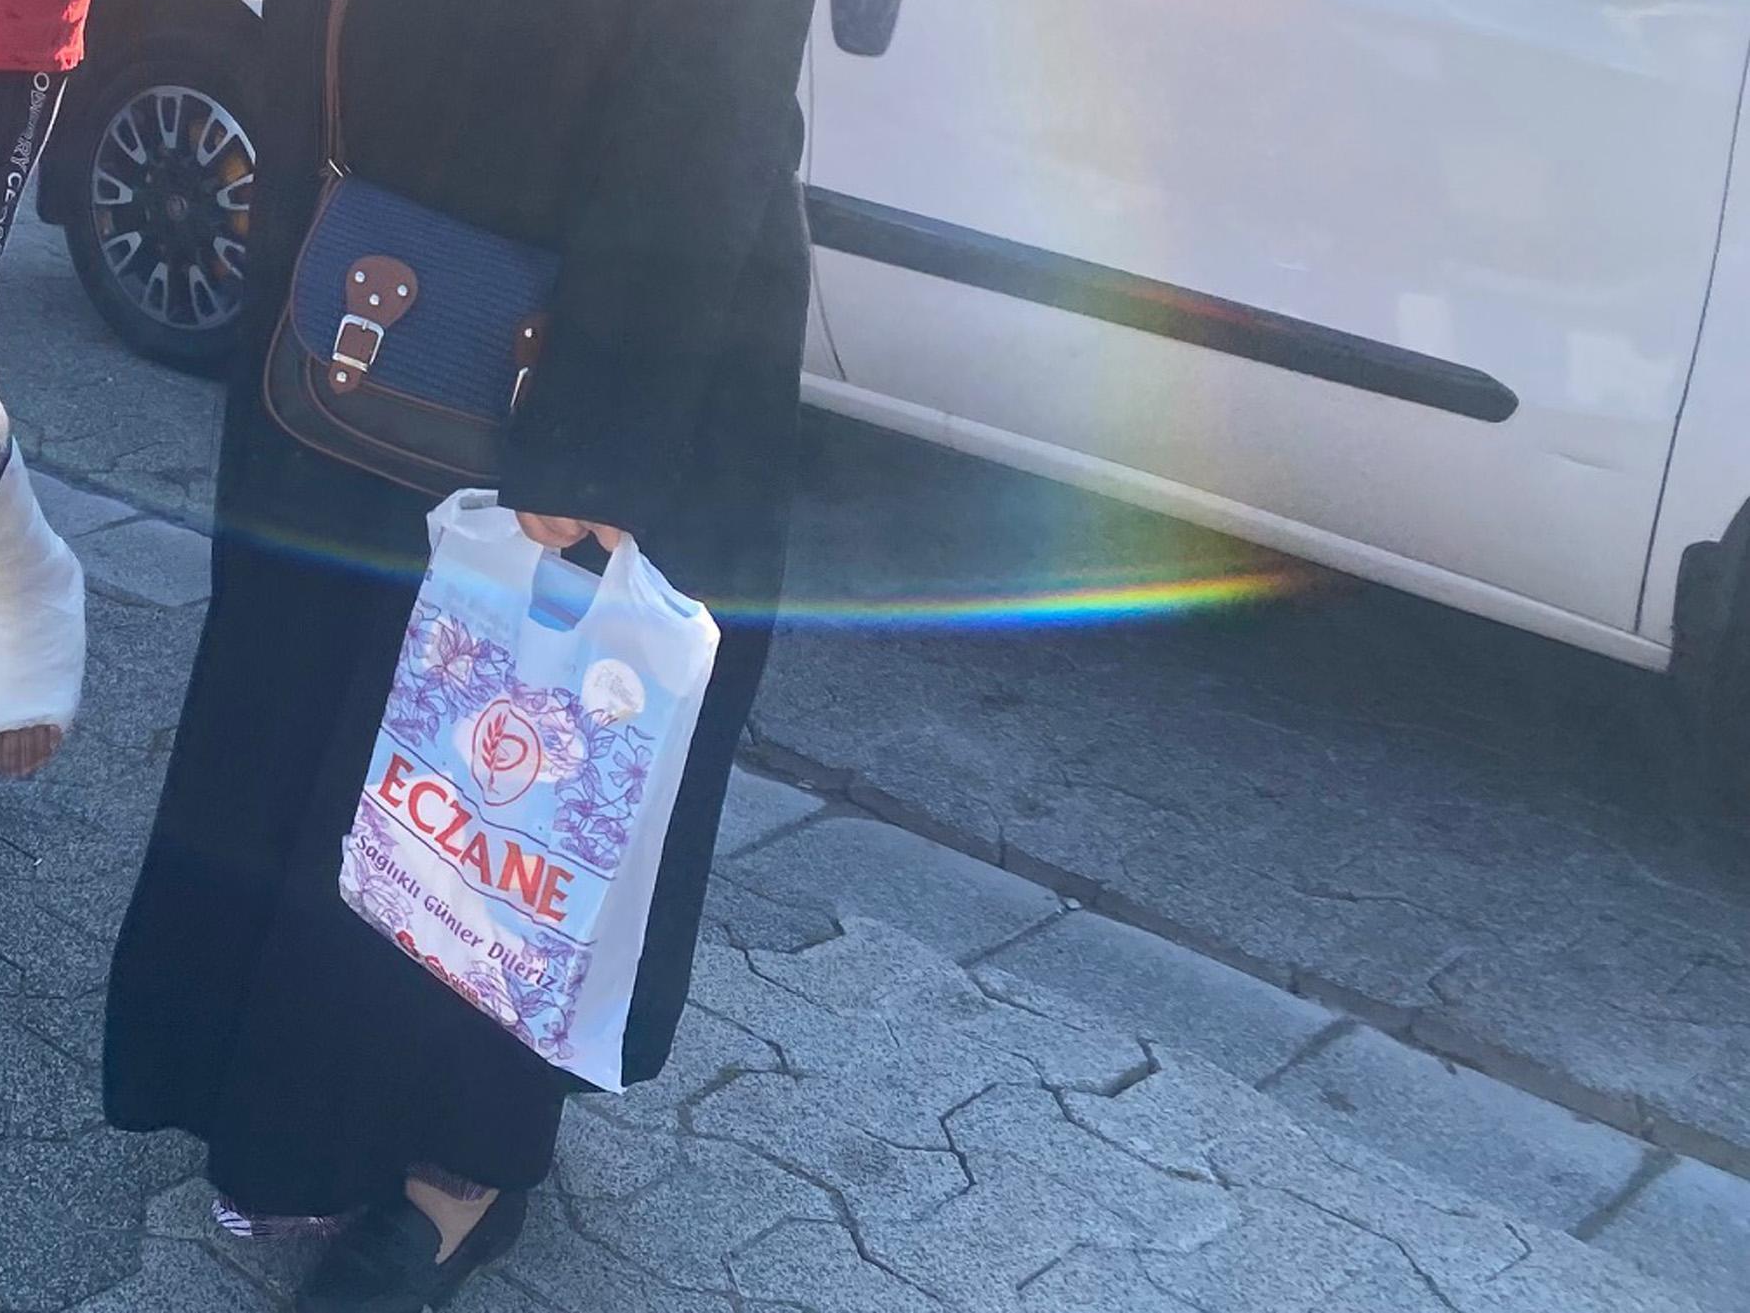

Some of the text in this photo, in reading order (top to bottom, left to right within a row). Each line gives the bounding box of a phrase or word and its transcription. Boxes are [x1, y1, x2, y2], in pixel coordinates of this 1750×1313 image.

[355, 834, 421, 898] Sağlıklı
[424, 895, 484, 948] Günler
[487, 941, 559, 992] Dileriz
[377, 752, 575, 922] ECZANE
